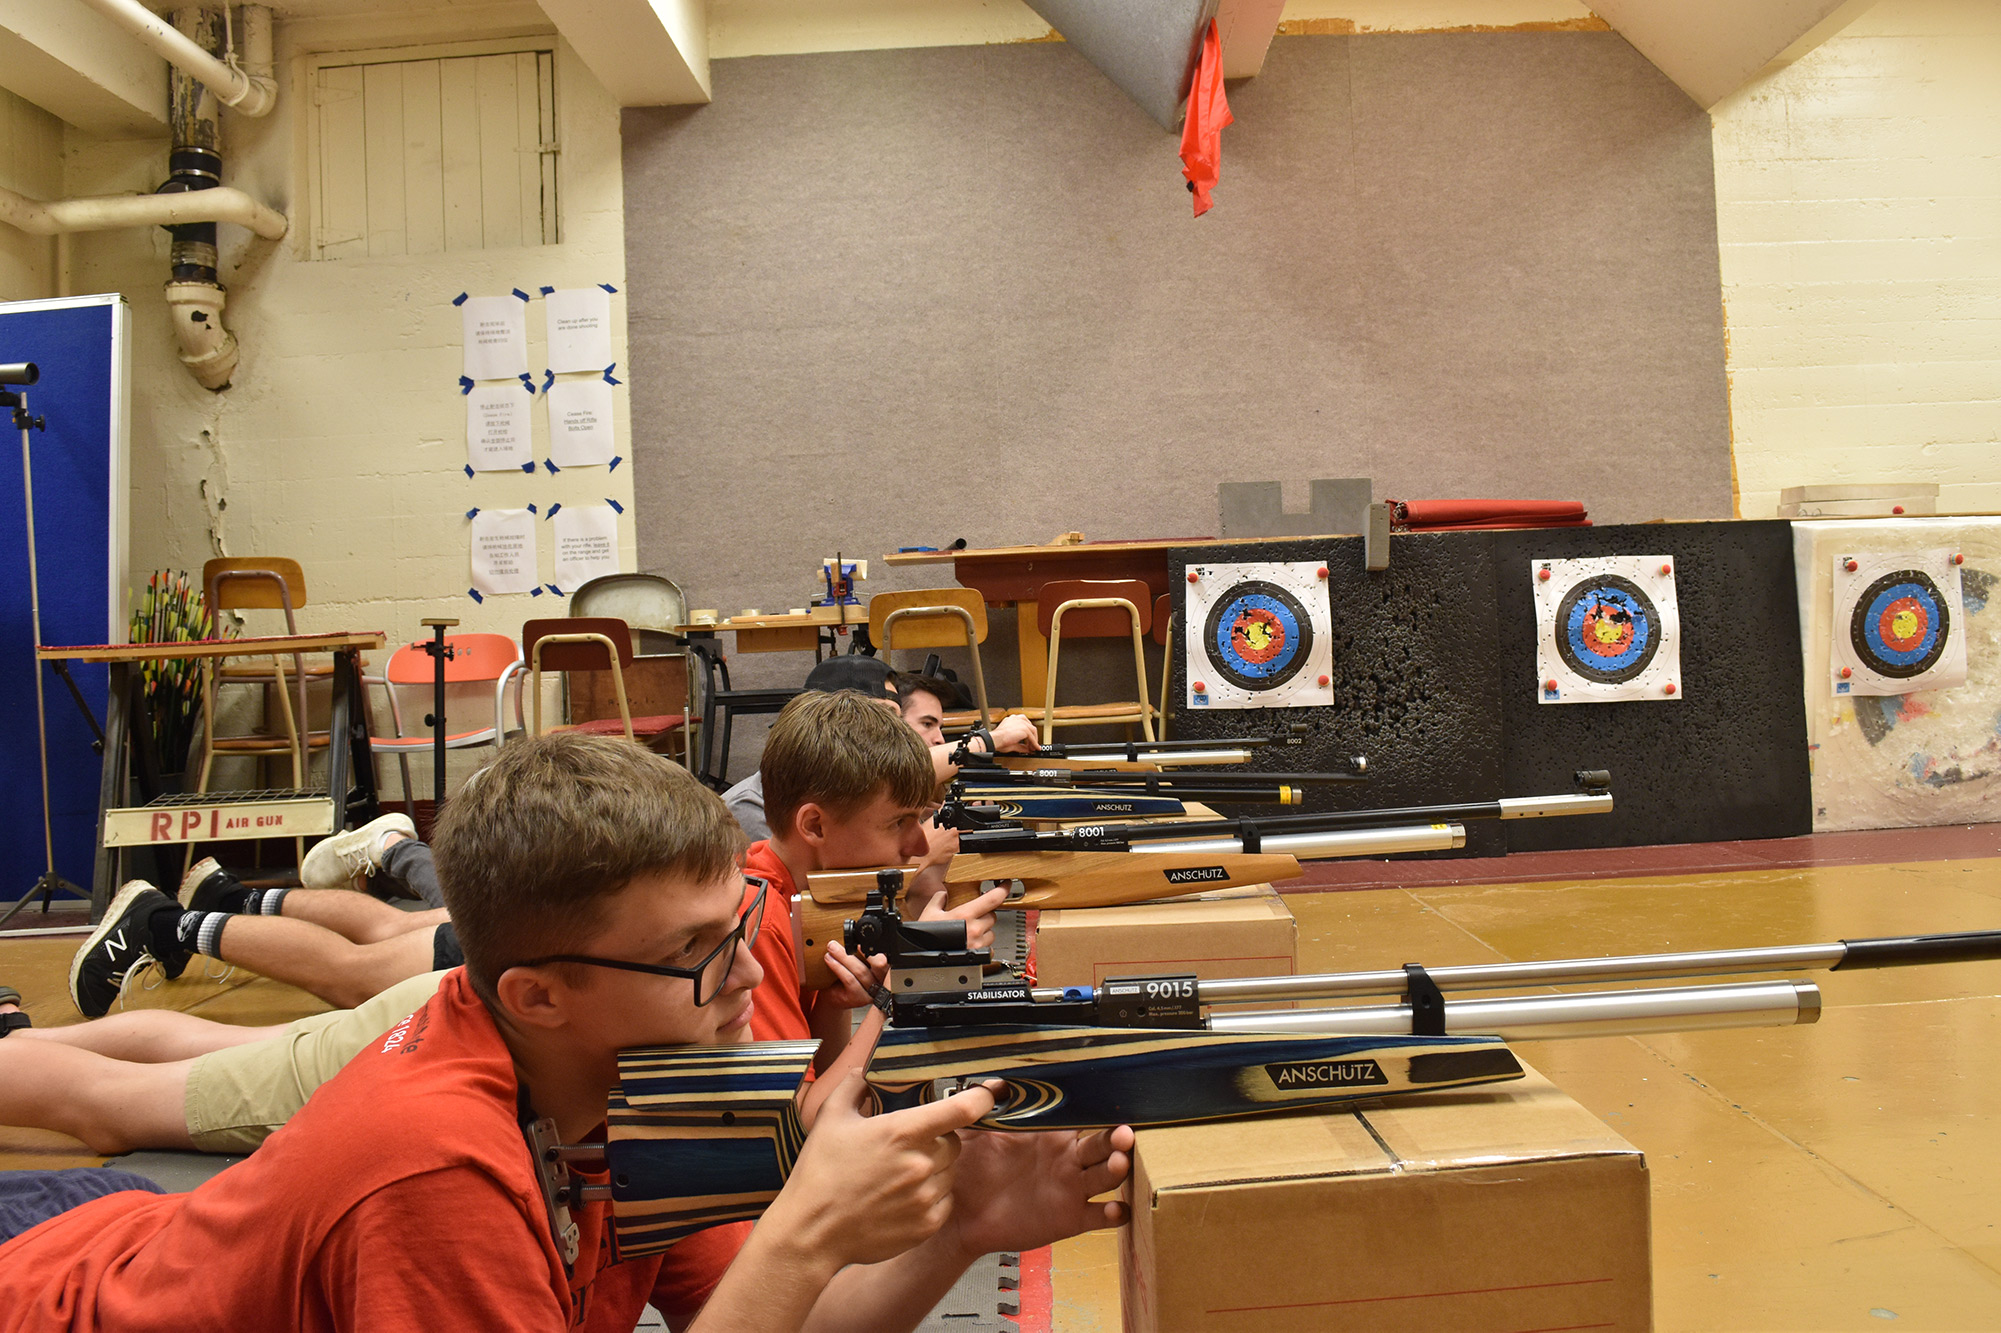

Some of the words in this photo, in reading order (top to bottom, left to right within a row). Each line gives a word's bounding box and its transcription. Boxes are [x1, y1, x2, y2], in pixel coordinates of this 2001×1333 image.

[226, 816, 249, 829] AIR
[256, 815, 283, 827] GUN
[1079, 826, 1105, 838] 8001
[967, 989, 1026, 1000] STABILISATOR
[1146, 981, 1193, 999] 9015
[1278, 1063, 1376, 1084] ANSCHÜTZ
